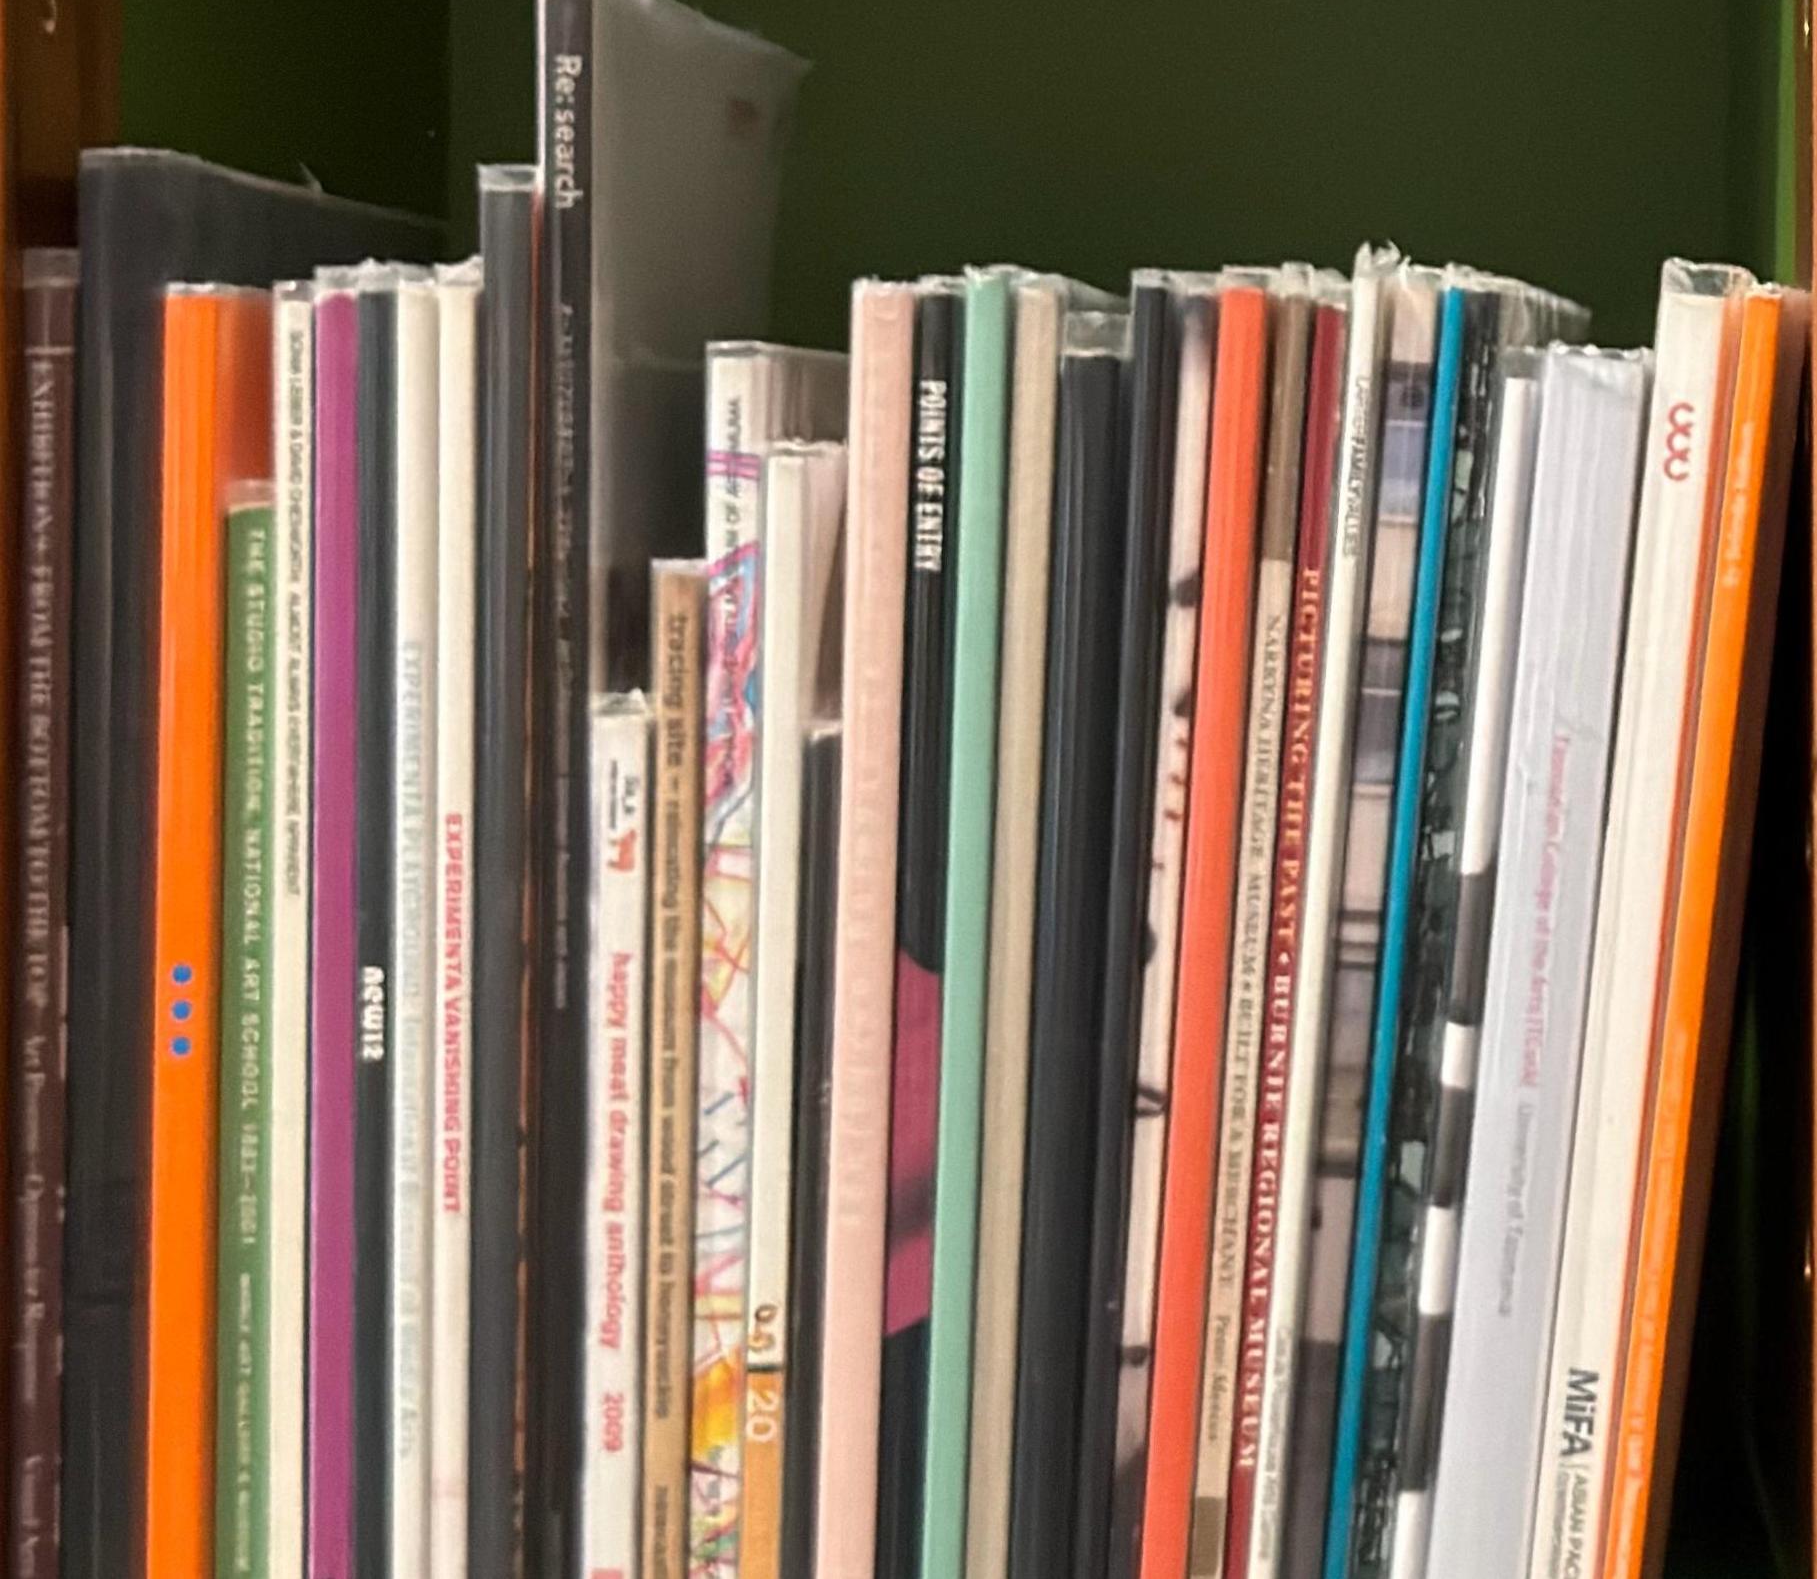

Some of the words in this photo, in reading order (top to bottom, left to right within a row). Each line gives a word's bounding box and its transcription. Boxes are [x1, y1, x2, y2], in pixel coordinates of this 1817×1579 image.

[918, 379, 948, 462] POINTS
[915, 466, 945, 497] OF
[247, 528, 267, 573] THE
[914, 502, 944, 573] ENTRY
[29, 564, 51, 648] FROM
[246, 582, 266, 674] STUDIO
[28, 653, 51, 709] THE
[663, 612, 689, 709] tracing
[1290, 568, 1321, 765] PICTURING
[667, 717, 688, 766] site
[1284, 776, 1306, 846] THE
[244, 827, 264, 944] NATIONAL
[444, 812, 464, 990] EXPERIMENTA
[1278, 859, 1300, 943] PAST
[244, 957, 261, 1002] ART
[607, 951, 634, 1028] happy
[241, 1011, 260, 1110] SCHOOL
[443, 996, 463, 1132] VANISHING
[609, 1036, 632, 1101] meat
[1264, 974, 1291, 1112] BURNIE
[442, 1136, 462, 1214] POINT
[603, 1109, 632, 1213] drawing
[1250, 1121, 1278, 1305] REGIONAL
[599, 1220, 627, 1350] anthology
[603, 1392, 626, 1454] 2009
[1238, 1316, 1267, 1470] MUSEUM
[1560, 1367, 1600, 1458] MiFA
[1568, 1474, 1591, 1534] ASIAN
[1563, 1536, 1585, 1579] PAC
